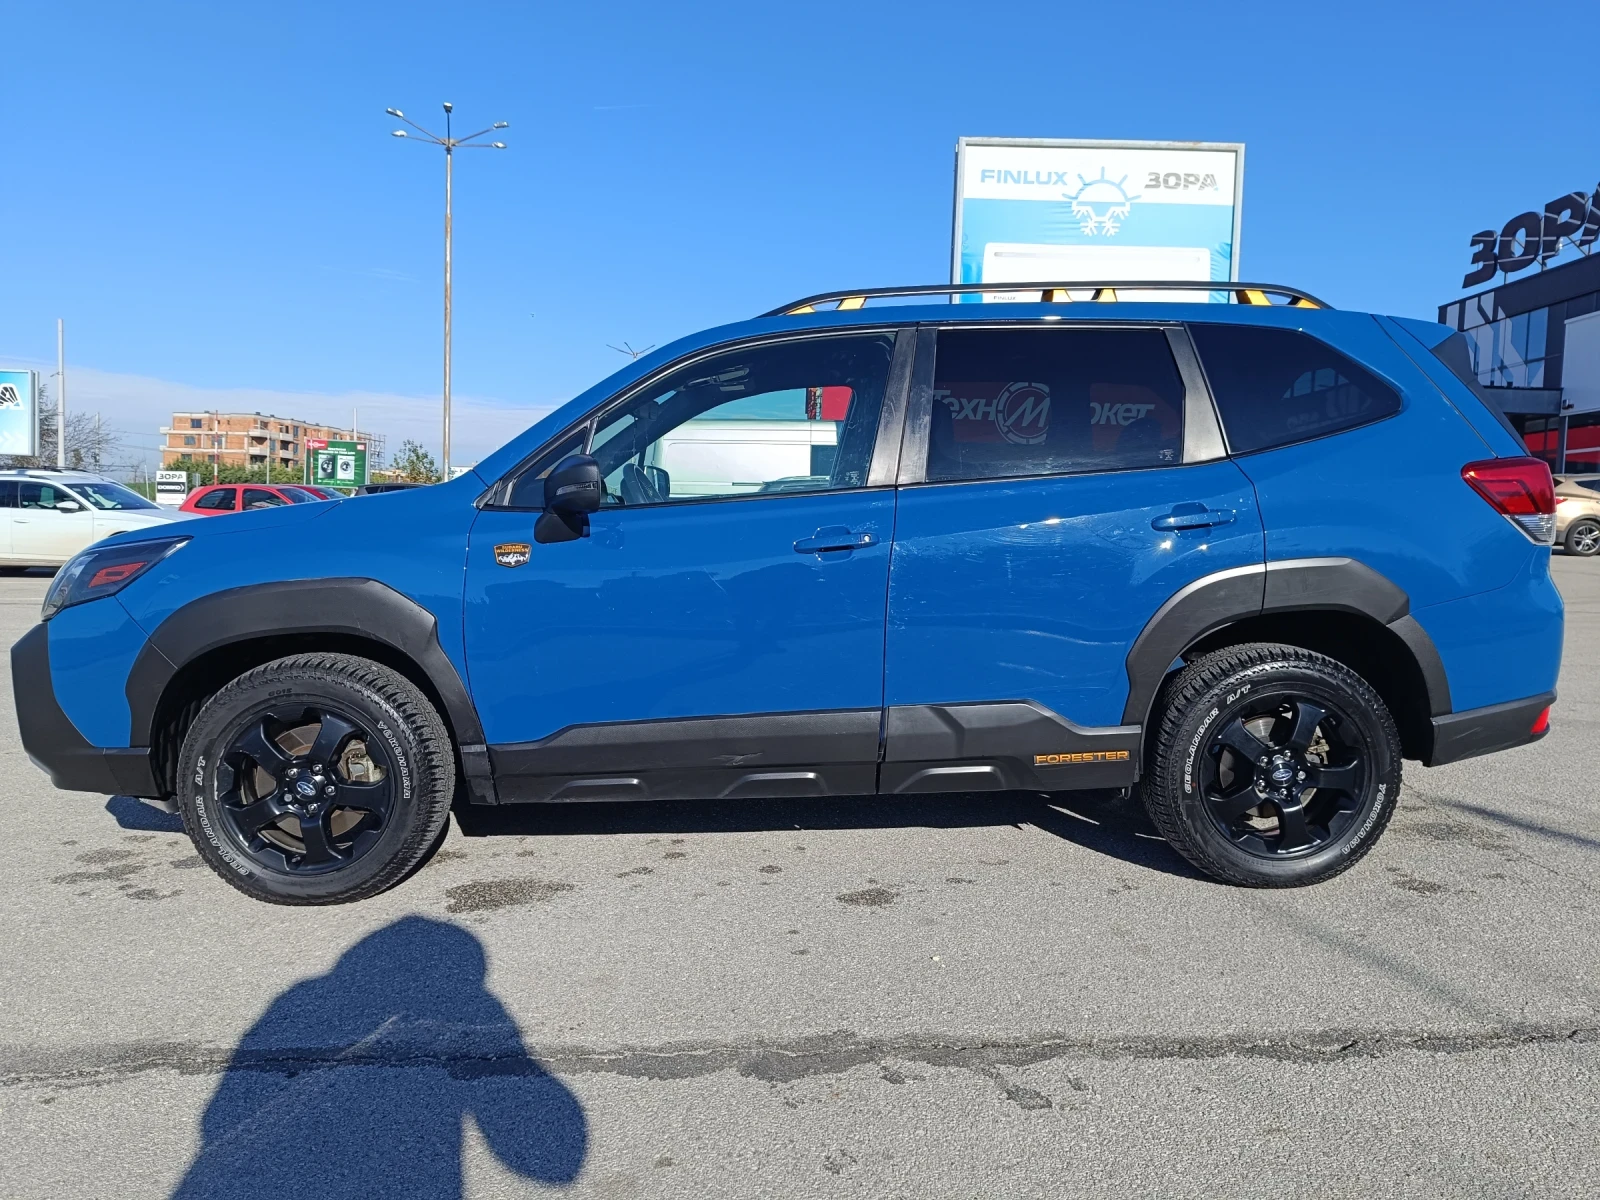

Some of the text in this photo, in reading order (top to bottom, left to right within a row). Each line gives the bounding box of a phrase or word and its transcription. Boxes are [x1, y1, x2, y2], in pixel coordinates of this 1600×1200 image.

[980, 169, 1068, 186] FINLUX
[1144, 172, 1218, 191] ЗОРА
[377, 720, 411, 798] YOKOHAMA
[1035, 751, 1129, 764] FORESTER
[1184, 684, 1251, 794] GEOLANDAR A/T
[195, 755, 250, 876] GEOLANDAR A/T
[1341, 783, 1387, 854] YOKOHAMA
